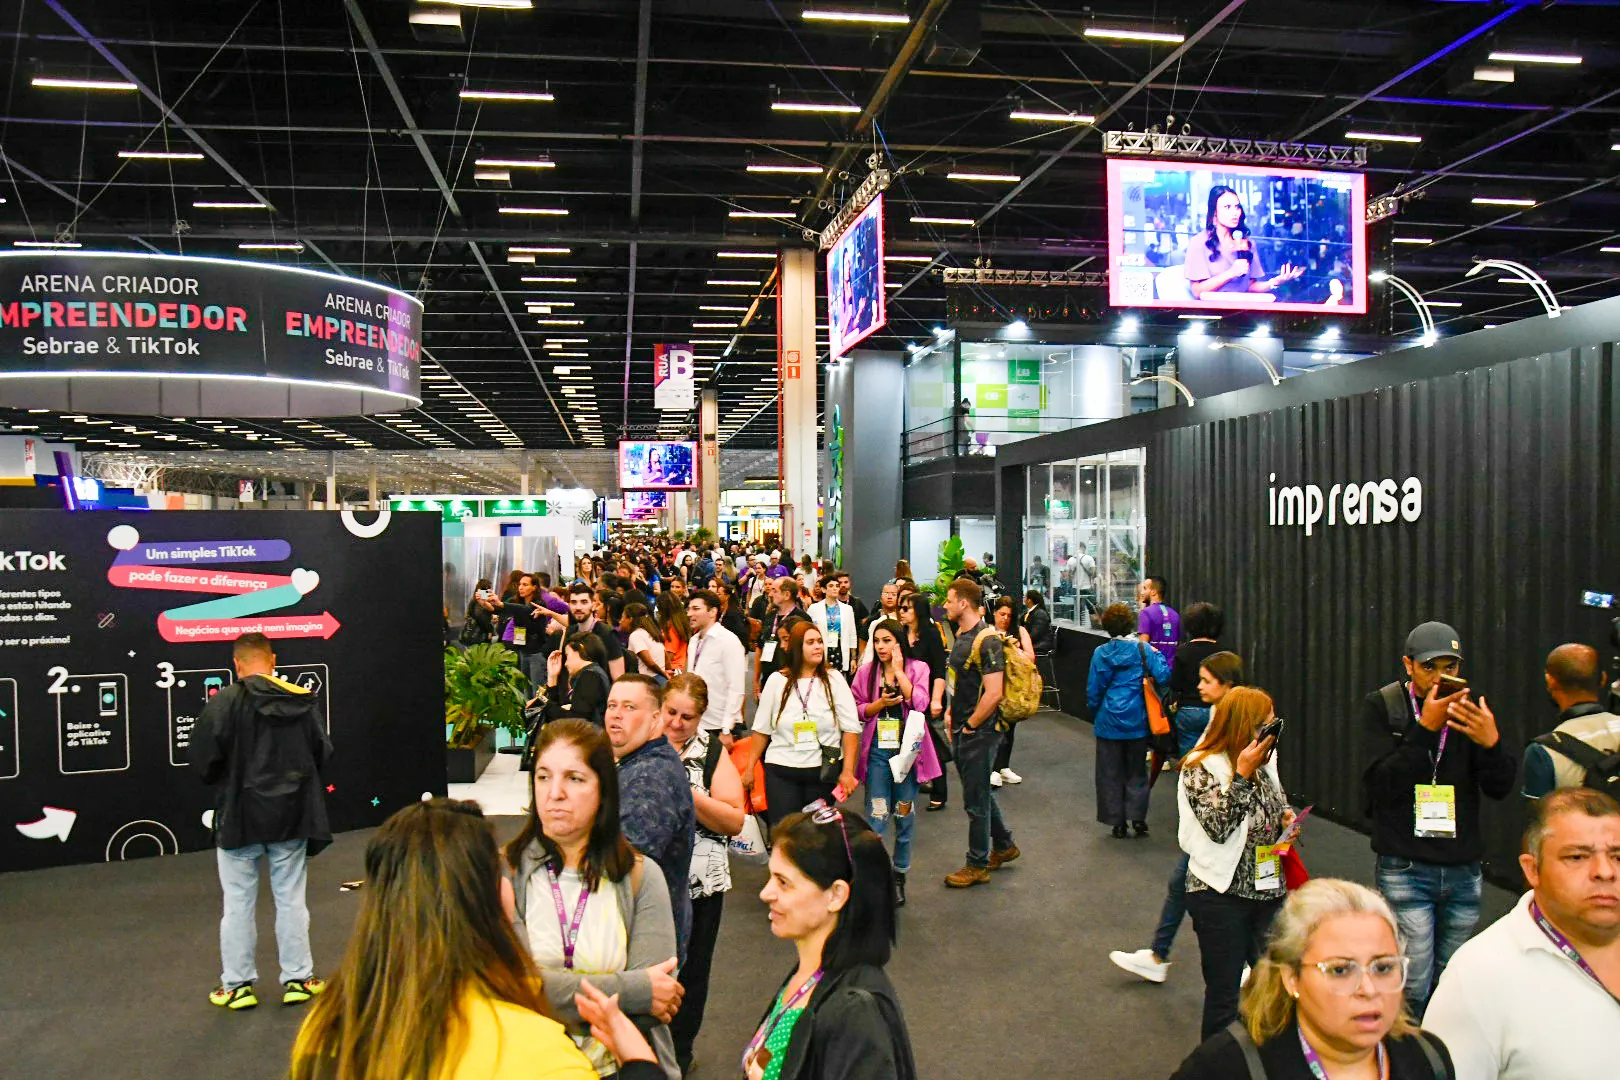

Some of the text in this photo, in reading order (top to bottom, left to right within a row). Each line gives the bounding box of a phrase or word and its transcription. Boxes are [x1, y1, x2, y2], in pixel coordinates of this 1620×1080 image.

[21, 275, 199, 295] ARENA CRIADOR
[325, 292, 411, 330] ARENA CRIADOR
[23, 336, 200, 355] Sebrae & TikTok
[285, 311, 421, 363] EMPREENDEDOR
[325, 348, 410, 381] Sebrae & TikTok
[658, 354, 668, 376] RUA
[670, 350, 694, 379] B
[1269, 472, 1422, 537] imprensa
[0, 551, 67, 571] kTok
[146, 546, 257, 561] Um simples TikTok
[129, 570, 163, 583] pode
[164, 571, 197, 584] fazer
[210, 576, 268, 591] diferença
[38, 589, 61, 600] tipos
[7, 601, 34, 610] estão
[35, 600, 72, 609] hitando
[34, 612, 58, 621] dias.
[175, 622, 323, 636] Negócios que você nem imagina
[4, 638, 20, 646] ser
[29, 635, 71, 647] próximo!
[47, 666, 81, 693] 2.
[155, 661, 186, 688] 3.
[66, 722, 92, 730] Baixe
[176, 715, 195, 723] Crie
[176, 723, 195, 733] perf
[67, 729, 111, 740] aplicativo
[67, 737, 108, 747] do TikTok
